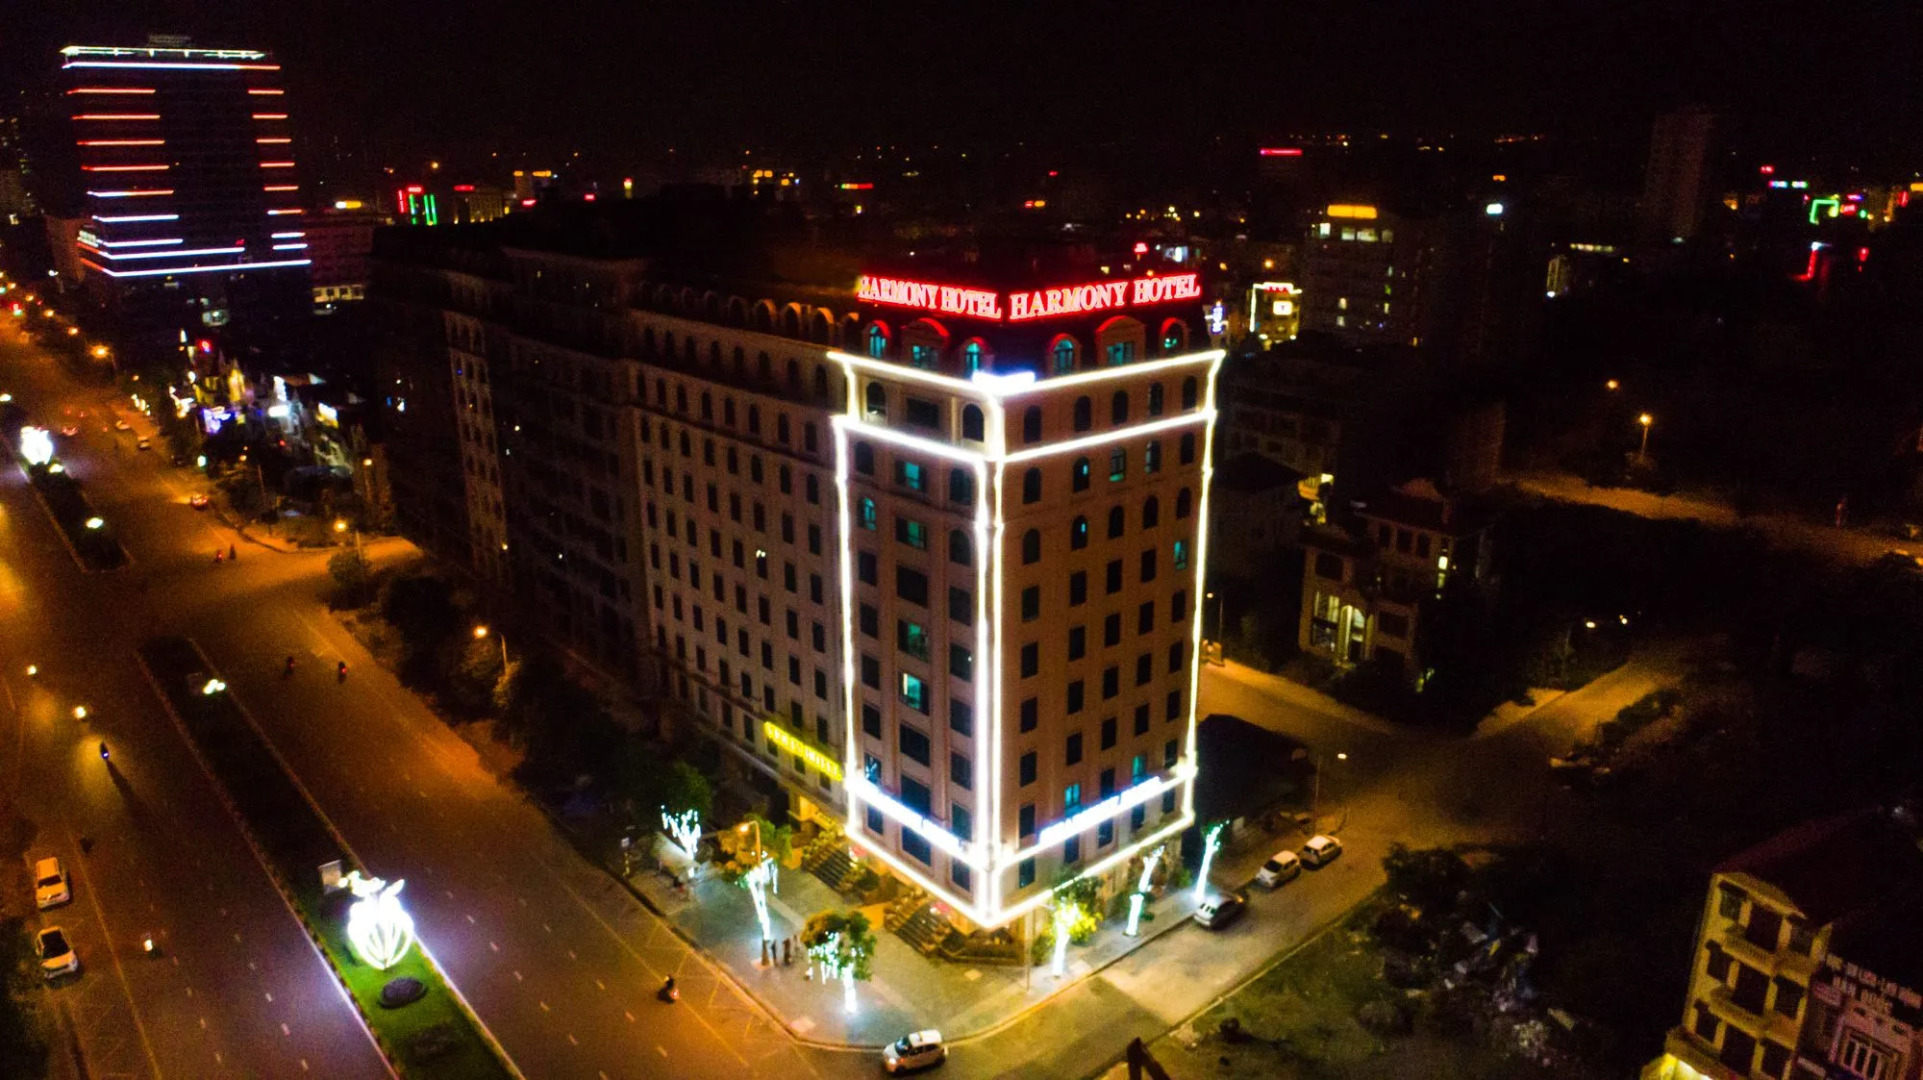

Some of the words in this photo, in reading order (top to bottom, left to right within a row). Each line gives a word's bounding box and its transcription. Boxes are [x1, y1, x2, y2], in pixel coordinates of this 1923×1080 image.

[858, 276, 938, 309] HARMONY
[940, 286, 1001, 319] HOTEL
[1009, 281, 1128, 319] HARMONY
[1133, 274, 1200, 303] HOTEL
